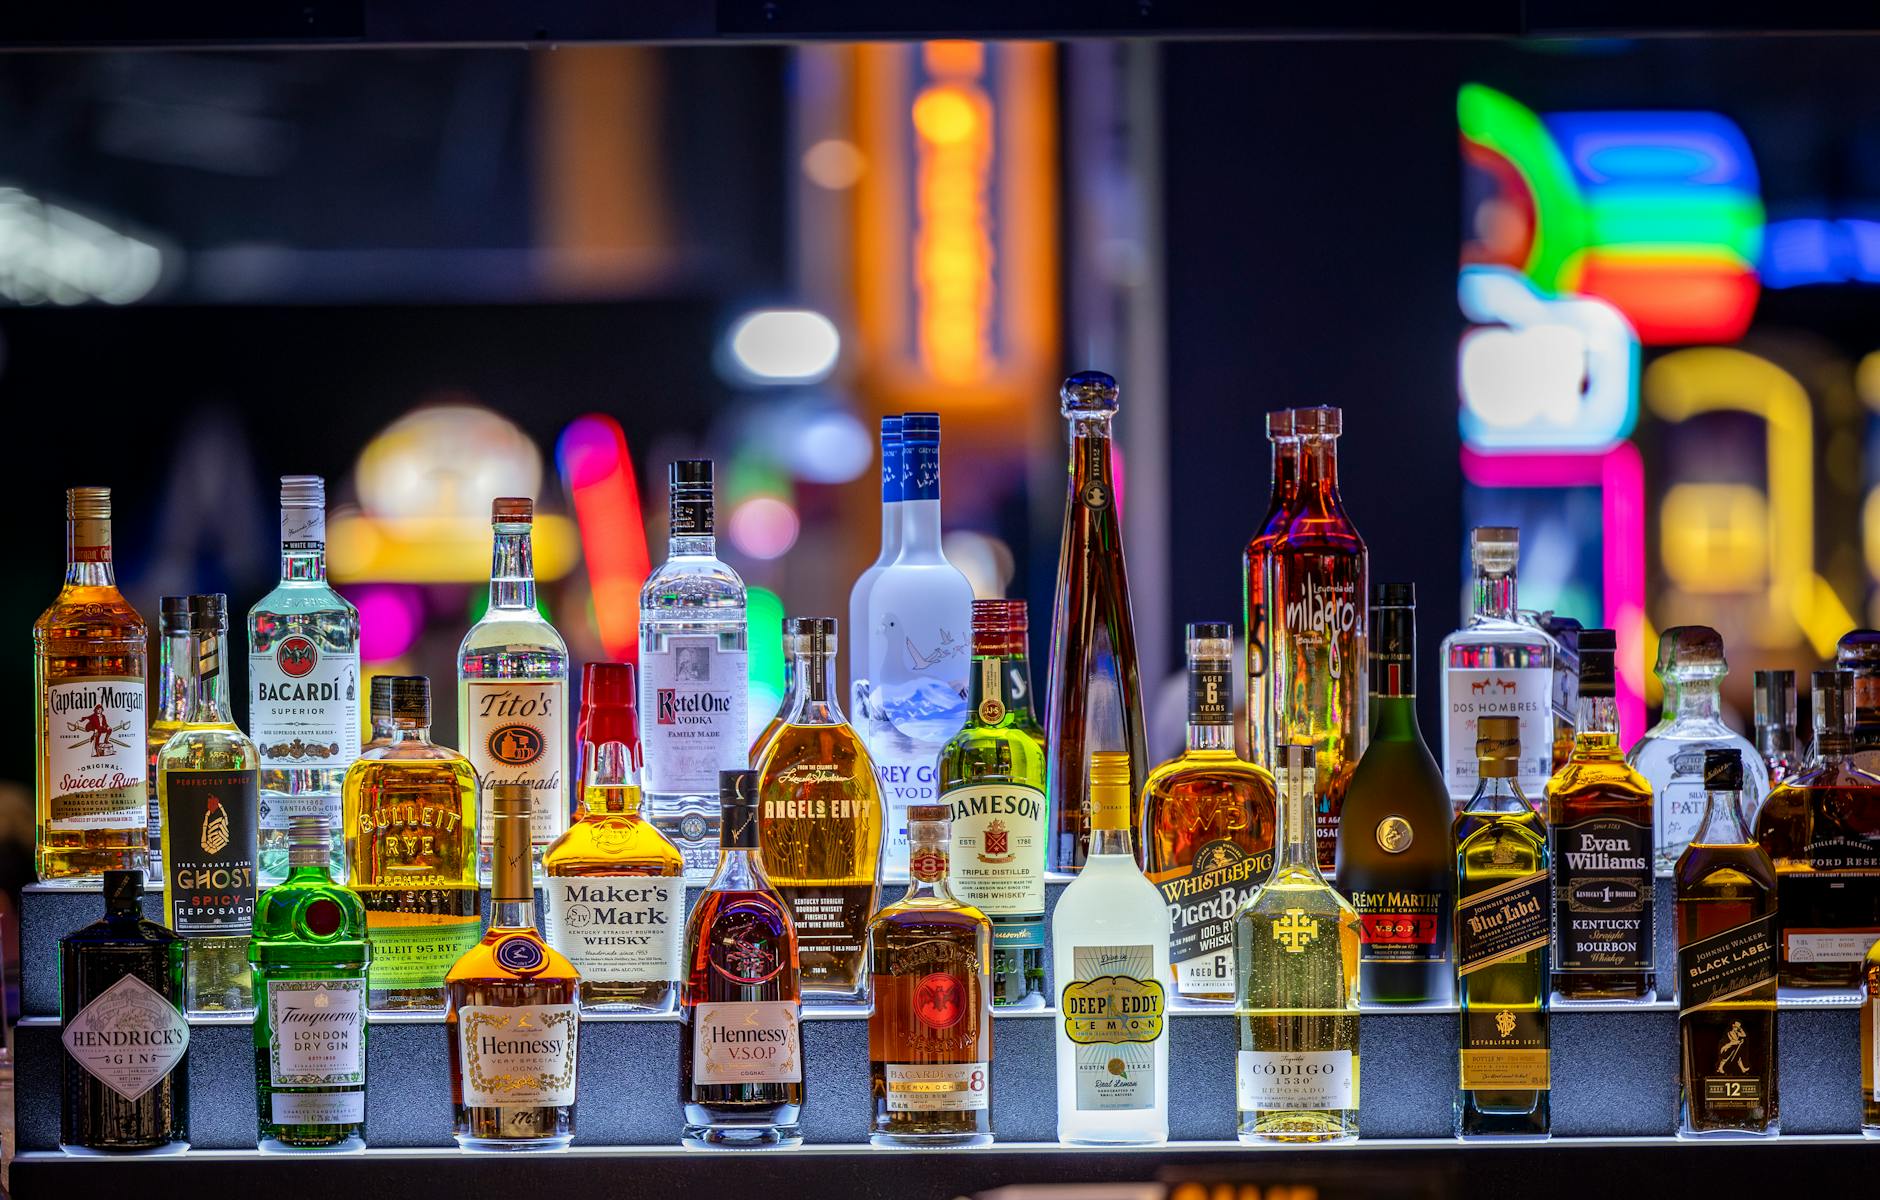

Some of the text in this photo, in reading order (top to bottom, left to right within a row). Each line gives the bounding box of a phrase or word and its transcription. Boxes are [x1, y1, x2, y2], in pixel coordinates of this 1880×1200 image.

[1344, 581, 1354, 593] del
[1286, 571, 1354, 679] milagro
[259, 677, 339, 701] BACARDÍ
[1207, 682, 1217, 704] 6
[51, 686, 143, 715] Captain Morgan
[480, 690, 551, 717] Tito's
[659, 691, 730, 721] Ketel One
[1200, 704, 1225, 712] YEARS
[1454, 702, 1537, 713] DOS HOMBRES
[678, 716, 712, 724] VODKA
[81, 763, 119, 771] ORIGINAL
[878, 766, 910, 782] REY
[60, 772, 139, 791] Spiced Rum
[895, 787, 935, 799] VOD
[765, 799, 871, 819] ANGELS ENVY
[950, 795, 1041, 823] JAMESON
[1671, 801, 1707, 815] PAT
[359, 806, 461, 834] BULLEIT
[385, 836, 434, 856] RYE
[1580, 833, 1631, 851] Evan
[921, 856, 936, 872] 8
[1565, 852, 1646, 870] Williams
[1846, 857, 1880, 866] RESE
[177, 868, 251, 889] GHOST
[376, 875, 445, 886] FRONTIER
[992, 868, 1030, 876] DISTILLED
[1162, 853, 1272, 903] WHISTLEPIG
[191, 895, 241, 906] SPICY
[565, 885, 668, 902] Maker's
[1352, 890, 1438, 907] RÉMY MARTIN
[1167, 883, 1264, 934] PIGGYBAC
[1474, 890, 1530, 915] JOHNNIE WALKER
[179, 907, 251, 916] REPOSADO
[593, 907, 667, 925] Mark
[1467, 913, 1503, 936] Blue
[1500, 896, 1540, 924] Label
[1572, 919, 1641, 930] KENTUCKY
[583, 936, 651, 945] WHISKY
[1200, 932, 1233, 952] WHISK
[1589, 931, 1624, 942] Straight
[374, 943, 458, 954] ULLEIT 95 RYE
[1576, 942, 1637, 952] BOURBON
[1697, 932, 1763, 962] JOHNNIE WALKER
[1191, 955, 1226, 978] AGED 6
[1590, 952, 1625, 965] Whiskey
[1689, 956, 1730, 978] BLACK
[1733, 942, 1772, 961] LABEL
[1692, 974, 1720, 988] BLENDED
[1722, 966, 1746, 976] SCOTCH
[1071, 995, 1158, 1014] DEEP EDDY
[281, 1006, 358, 1026] Tanqueray
[1075, 1020, 1155, 1030] LEMON
[73, 1029, 183, 1047] HENDRICK'S
[294, 1030, 348, 1041] LONDON
[713, 1026, 788, 1046] Hennessy
[294, 1041, 348, 1051] DRY GIN
[482, 1036, 564, 1057] Hennessy
[728, 1046, 777, 1060] V.S.O.P
[114, 1053, 148, 1064] GIN
[1253, 1061, 1334, 1076] CÓDIGO
[970, 1070, 986, 1092] 8
[1095, 1079, 1138, 1088] Real Lemon
[1275, 1077, 1309, 1085] 1530
[1725, 1082, 1741, 1097] 12
